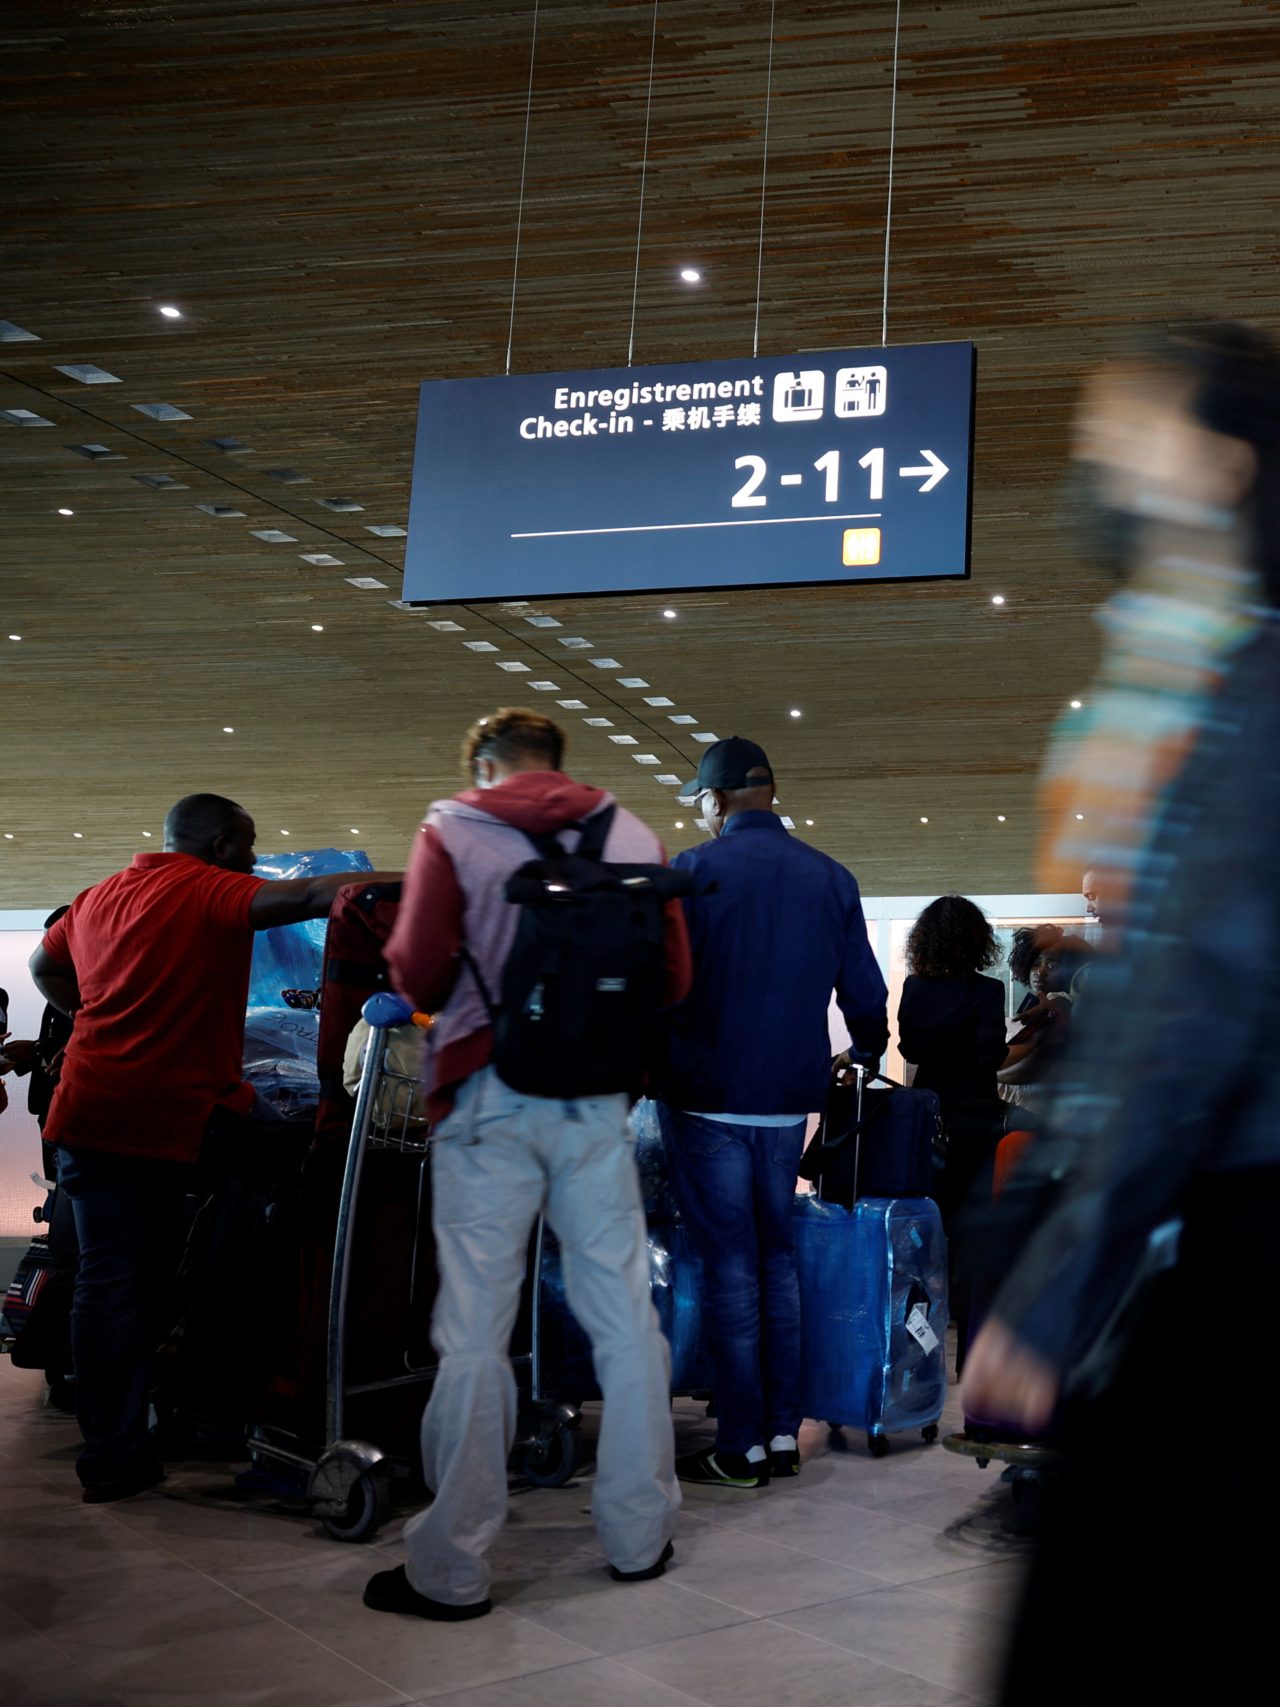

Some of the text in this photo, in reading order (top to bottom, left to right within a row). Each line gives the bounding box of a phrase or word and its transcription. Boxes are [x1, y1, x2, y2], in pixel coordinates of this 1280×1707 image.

[553, 375, 764, 411] Enregistrement
[519, 410, 634, 440] Check-in
[661, 402, 762, 432] 乘机手续
